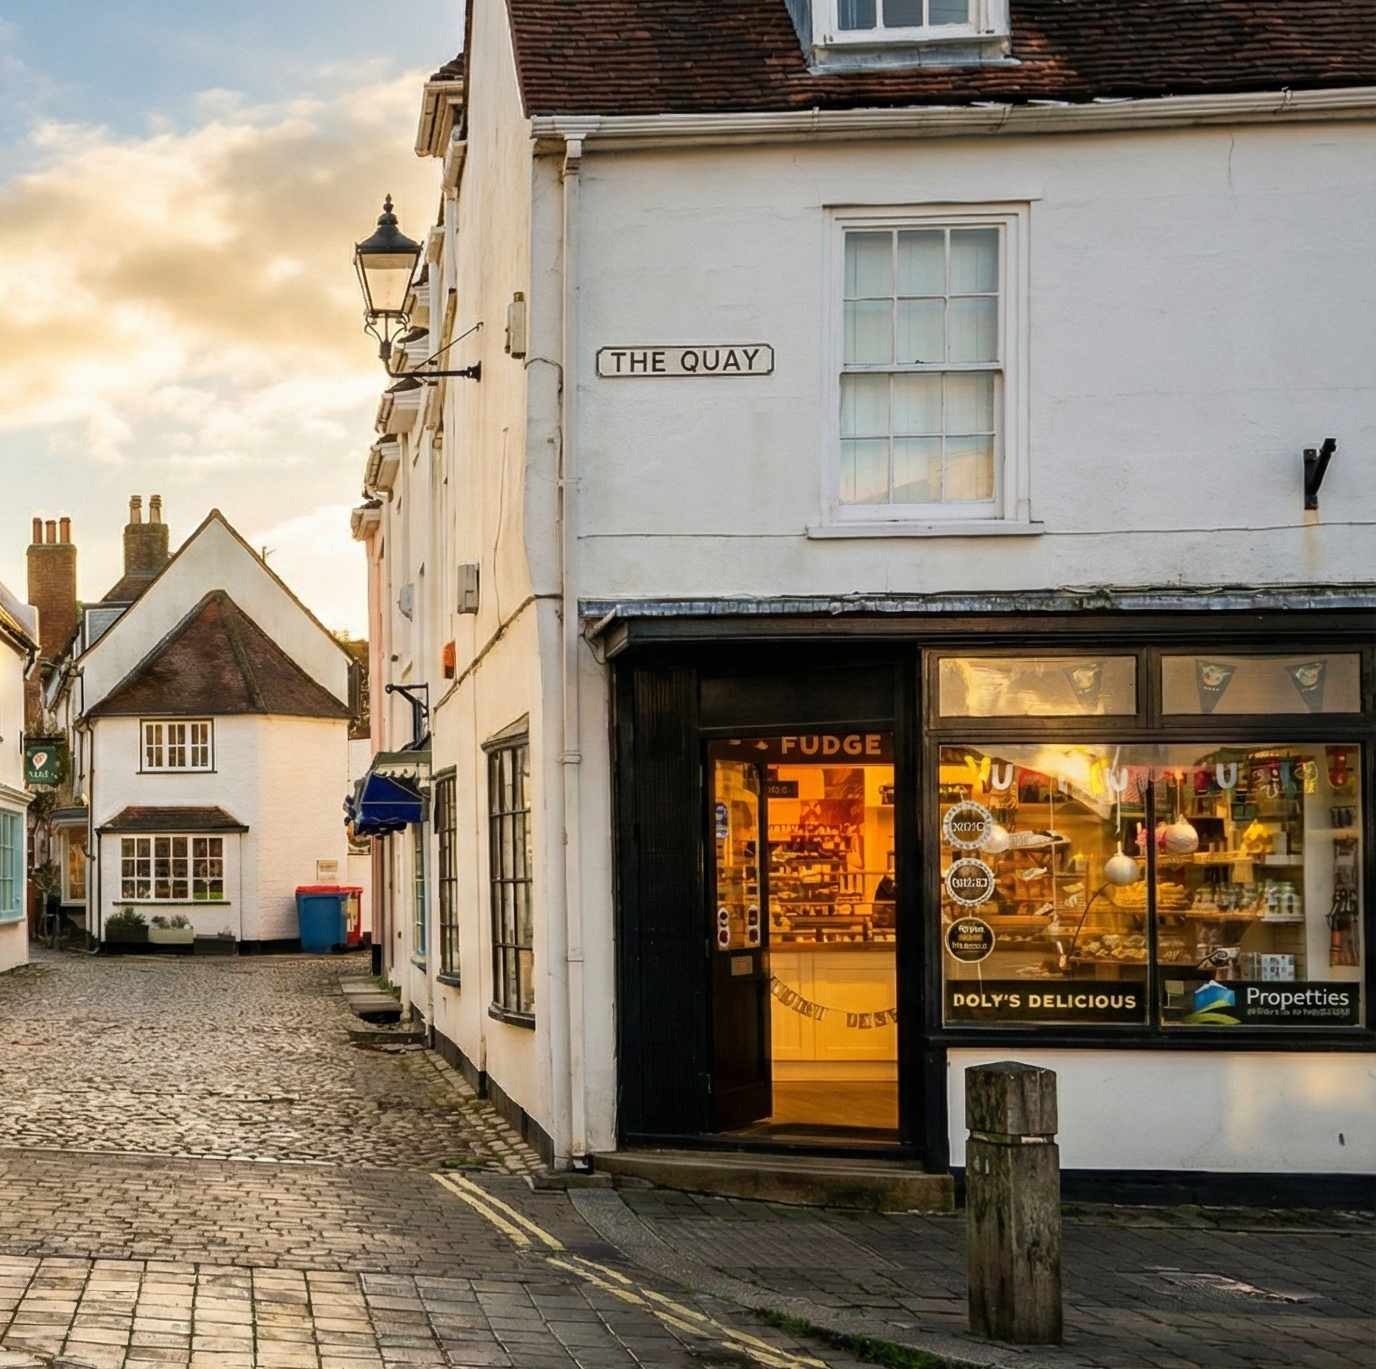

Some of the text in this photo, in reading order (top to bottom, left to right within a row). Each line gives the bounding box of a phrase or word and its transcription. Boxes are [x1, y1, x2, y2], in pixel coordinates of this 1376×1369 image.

[610, 349, 760, 373] THE QUAY
[781, 734, 882, 755] FUDGE
[953, 993, 1137, 1009] DOLY'S DELICIOUS
[1246, 987, 1350, 1011] Propetties
